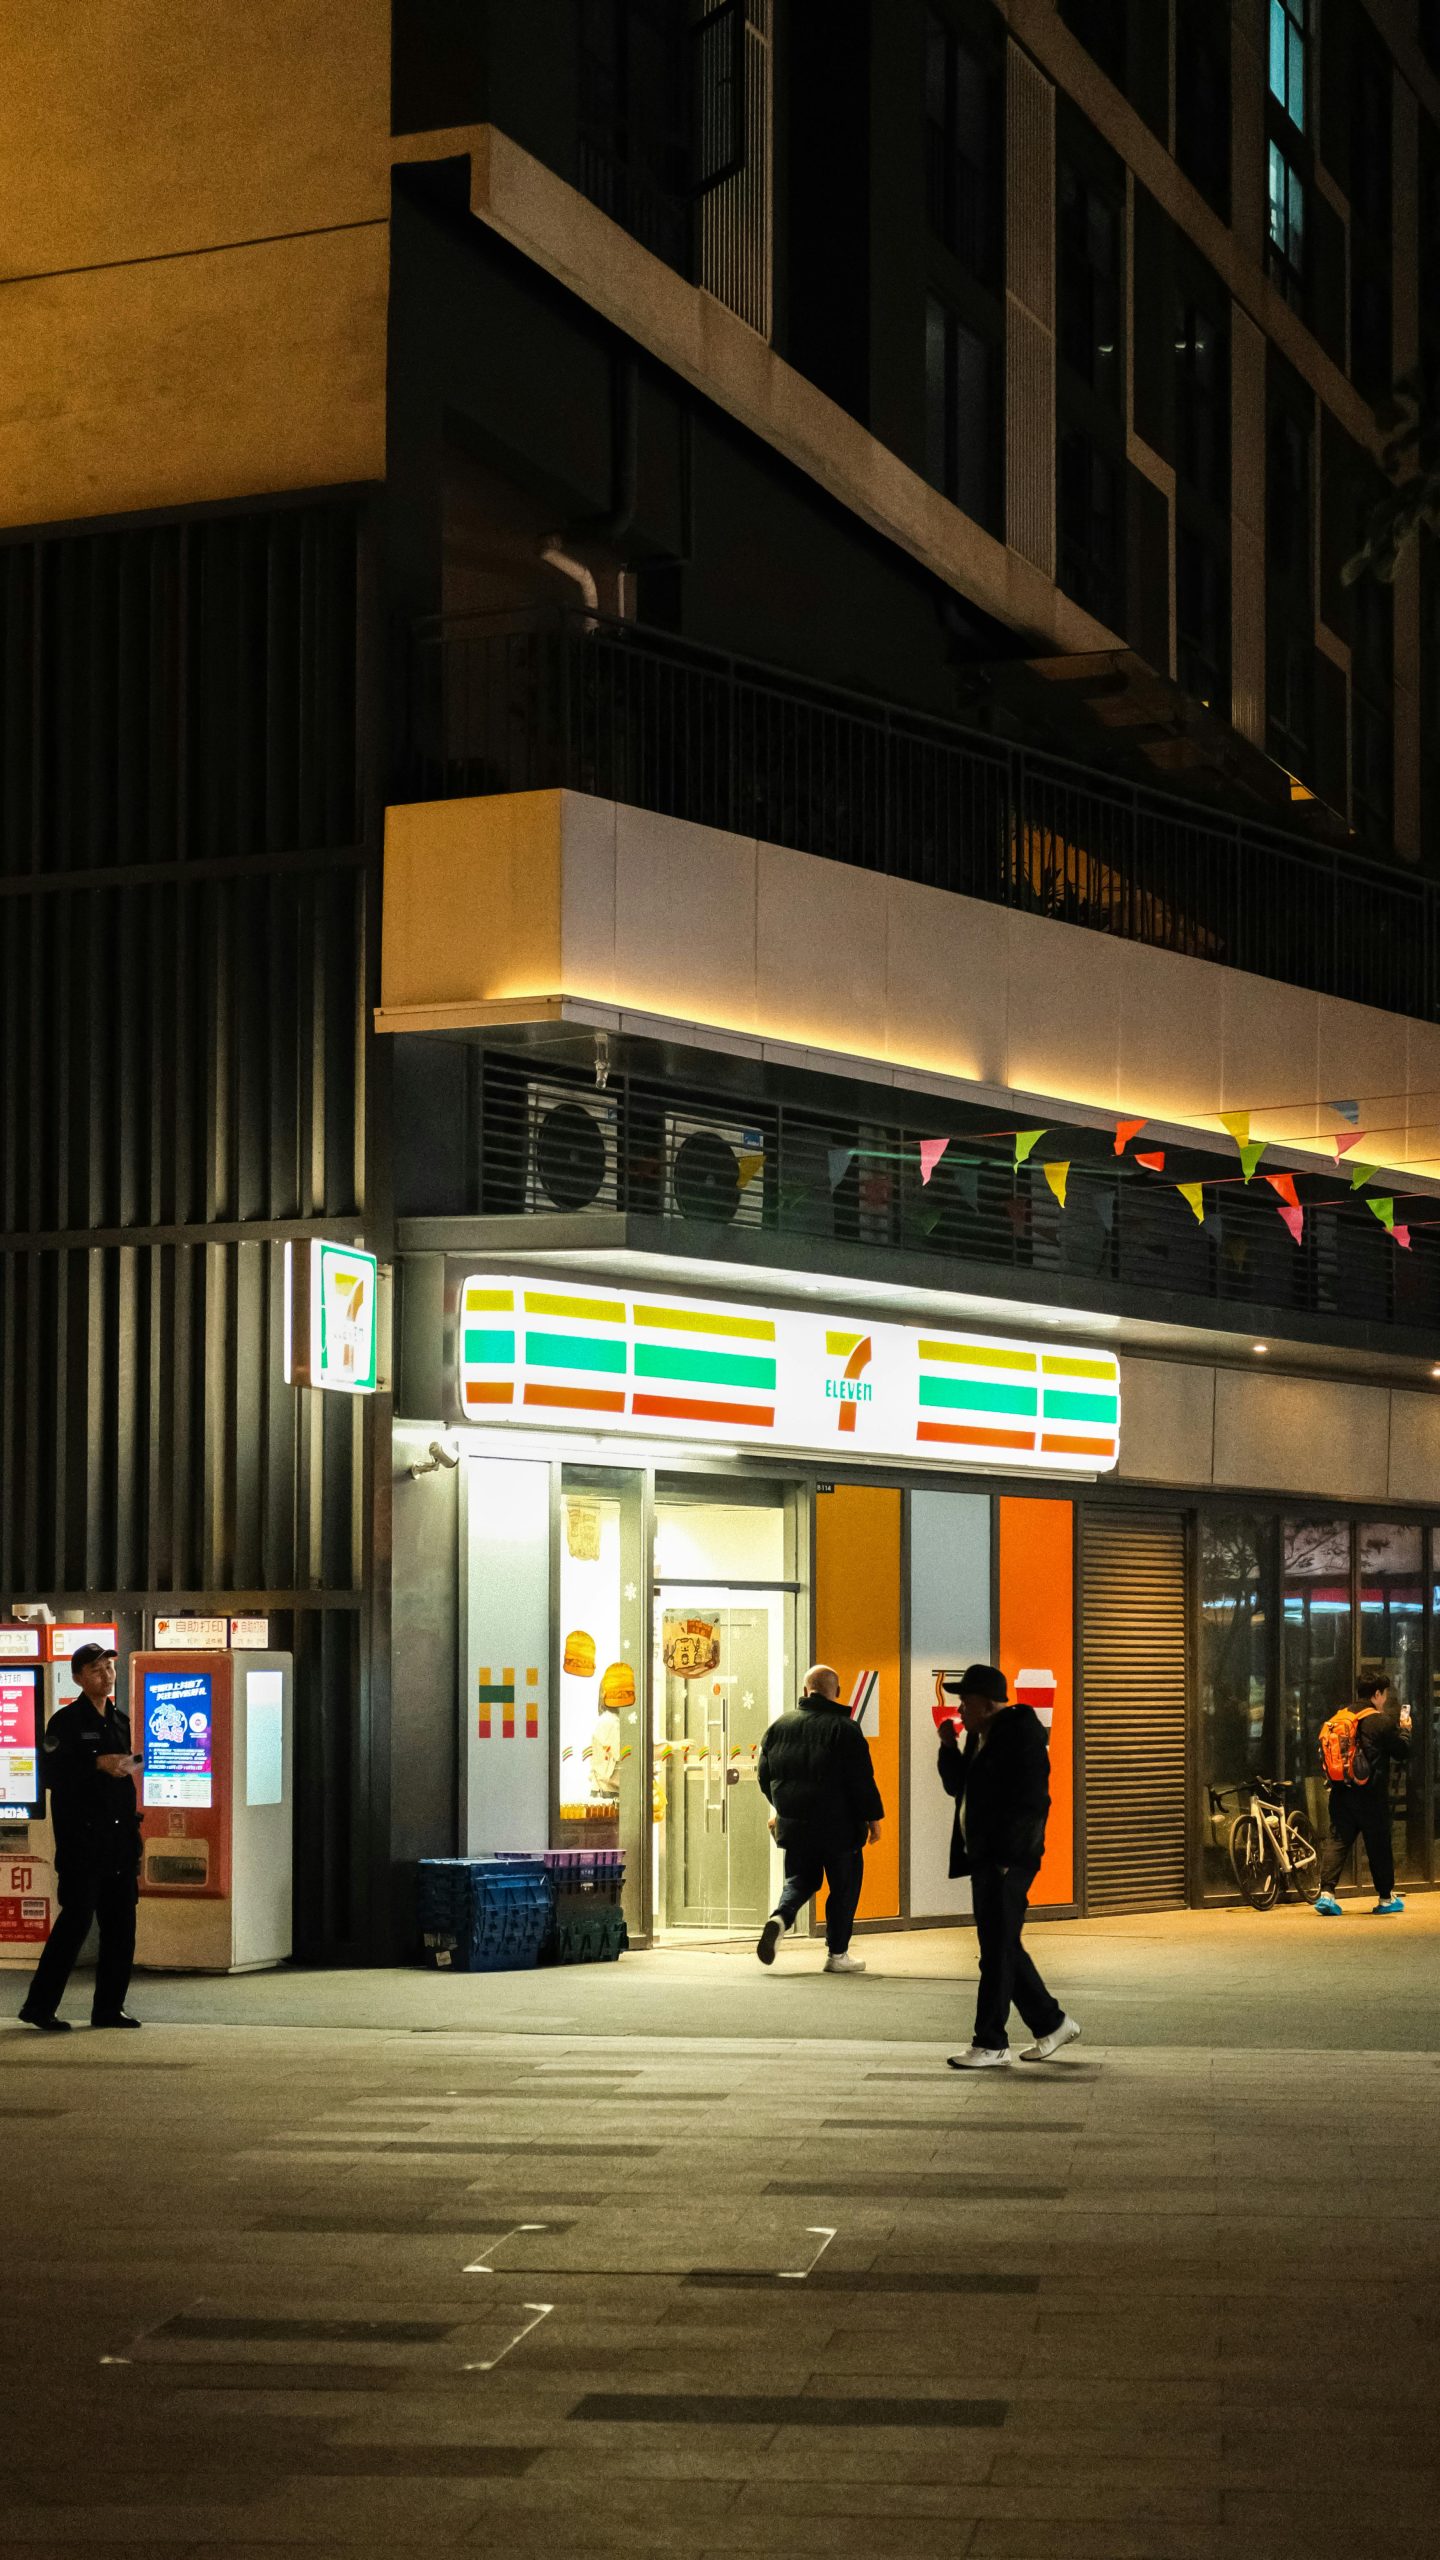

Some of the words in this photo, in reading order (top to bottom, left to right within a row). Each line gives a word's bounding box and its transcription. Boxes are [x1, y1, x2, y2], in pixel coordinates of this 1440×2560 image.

[825, 1331, 872, 1432] 7
[825, 1379, 872, 1402] ELEVEN
[176, 1620, 224, 1633] 自助打印
[479, 1667, 538, 1738] Hi
[0, 1866, 32, 1893] 印
